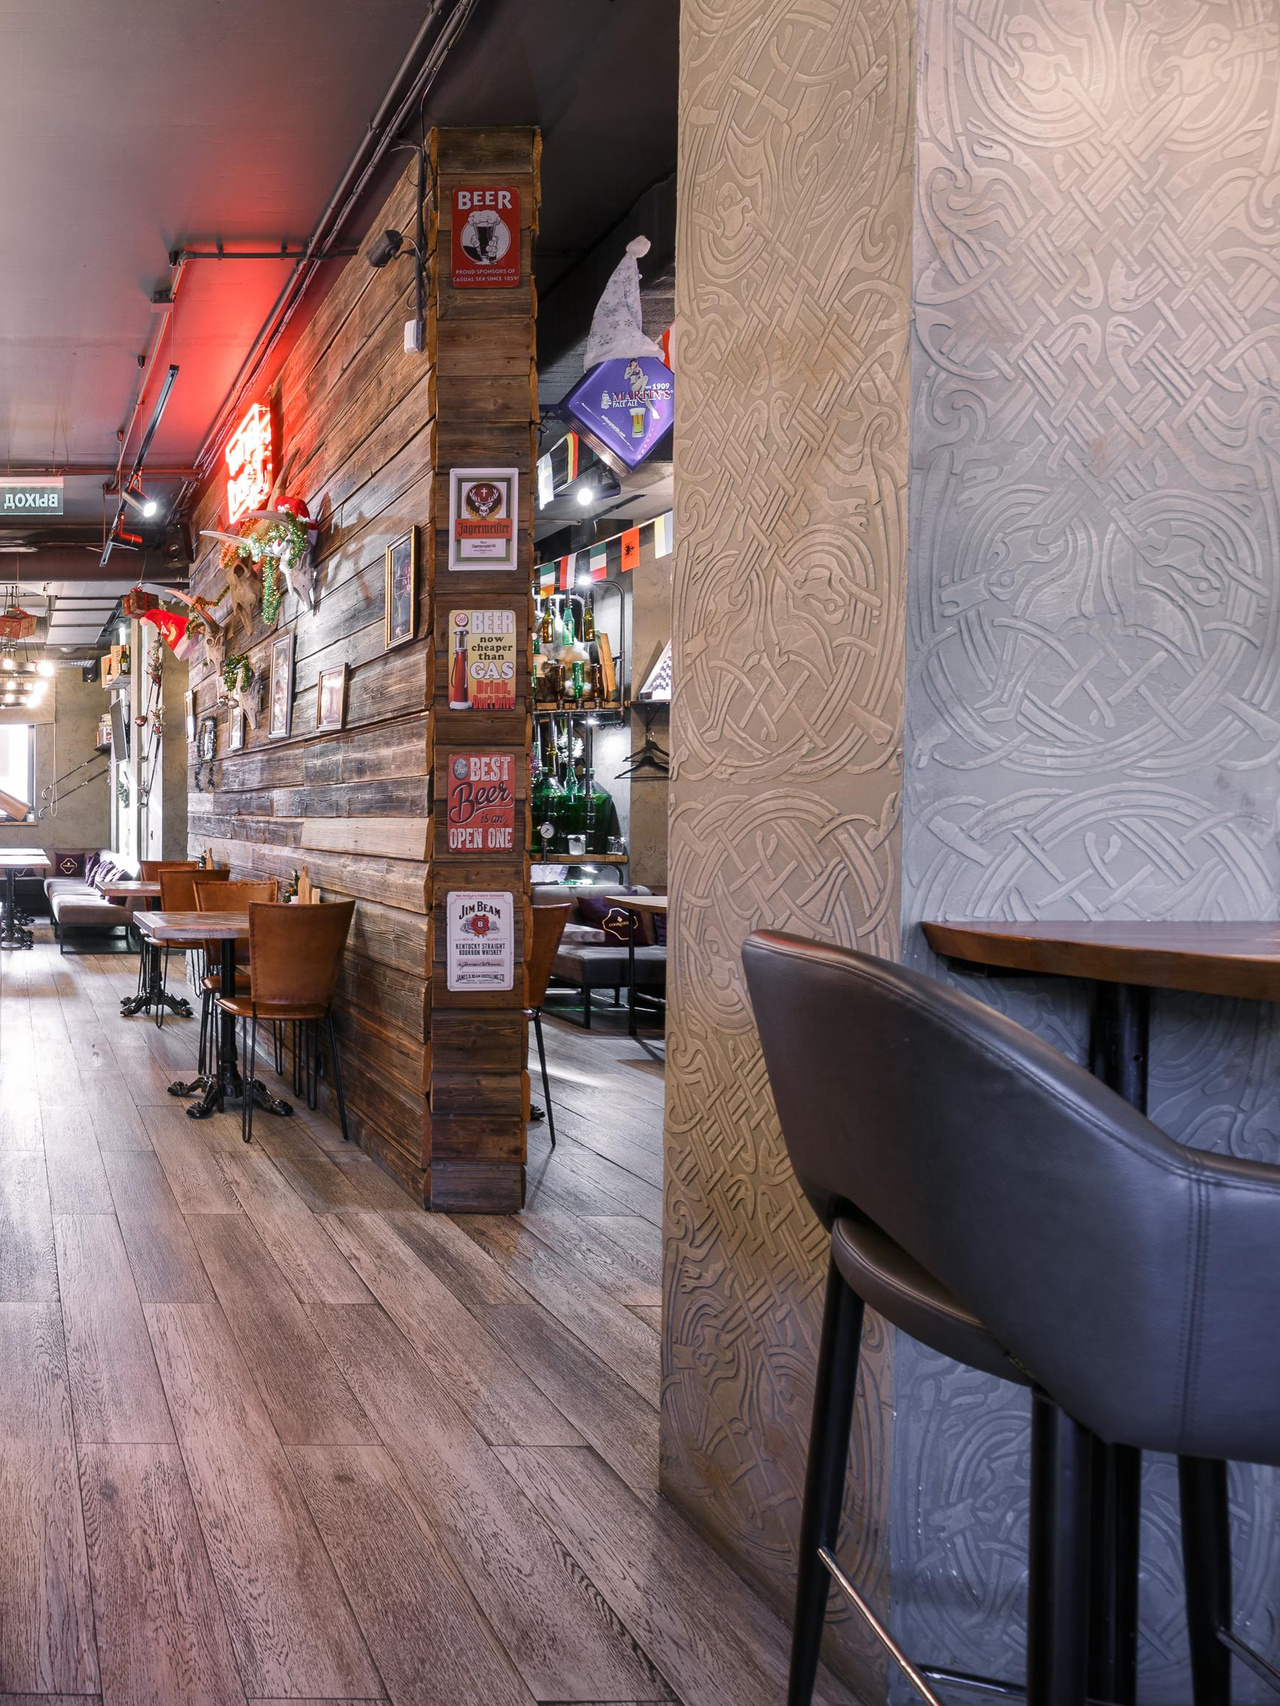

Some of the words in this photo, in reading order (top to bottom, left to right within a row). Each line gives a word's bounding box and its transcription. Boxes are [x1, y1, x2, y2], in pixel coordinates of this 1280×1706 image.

[458, 191, 512, 209] BEER
[652, 382, 670, 390] 1909
[612, 400, 626, 408] PALE
[471, 611, 514, 635] BEER
[471, 643, 513, 653] cheaper
[478, 652, 505, 661] than
[470, 661, 514, 679] GAS
[476, 680, 511, 695] Drink,
[470, 757, 511, 781] BEST
[449, 781, 513, 825] Beer
[481, 813, 489, 823] is
[492, 814, 505, 824] an
[449, 828, 483, 848] OPEN
[487, 827, 513, 848] ONE
[459, 904, 474, 919] JIM
[477, 901, 501, 919] BEAM
